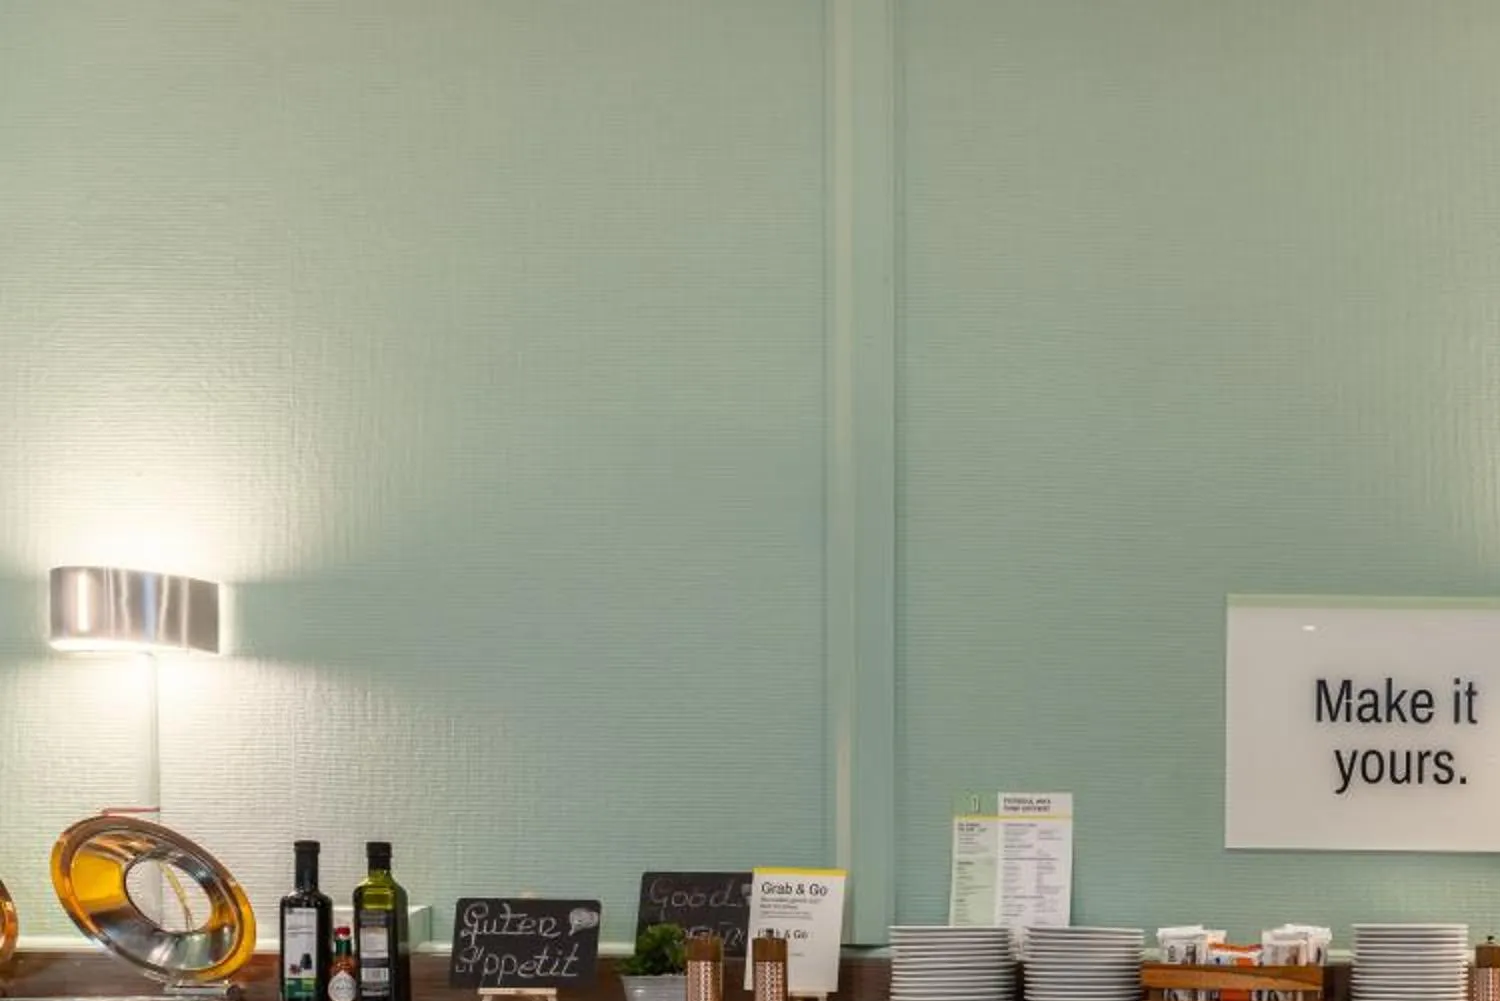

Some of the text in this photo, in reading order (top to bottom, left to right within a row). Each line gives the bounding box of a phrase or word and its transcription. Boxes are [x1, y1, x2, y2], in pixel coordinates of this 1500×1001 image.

[1315, 677, 1478, 724] Make it
[1334, 748, 1468, 794] yours.
[650, 876, 742, 921] Good
[761, 881, 829, 897] Grab & Go
[462, 901, 562, 946] Guten
